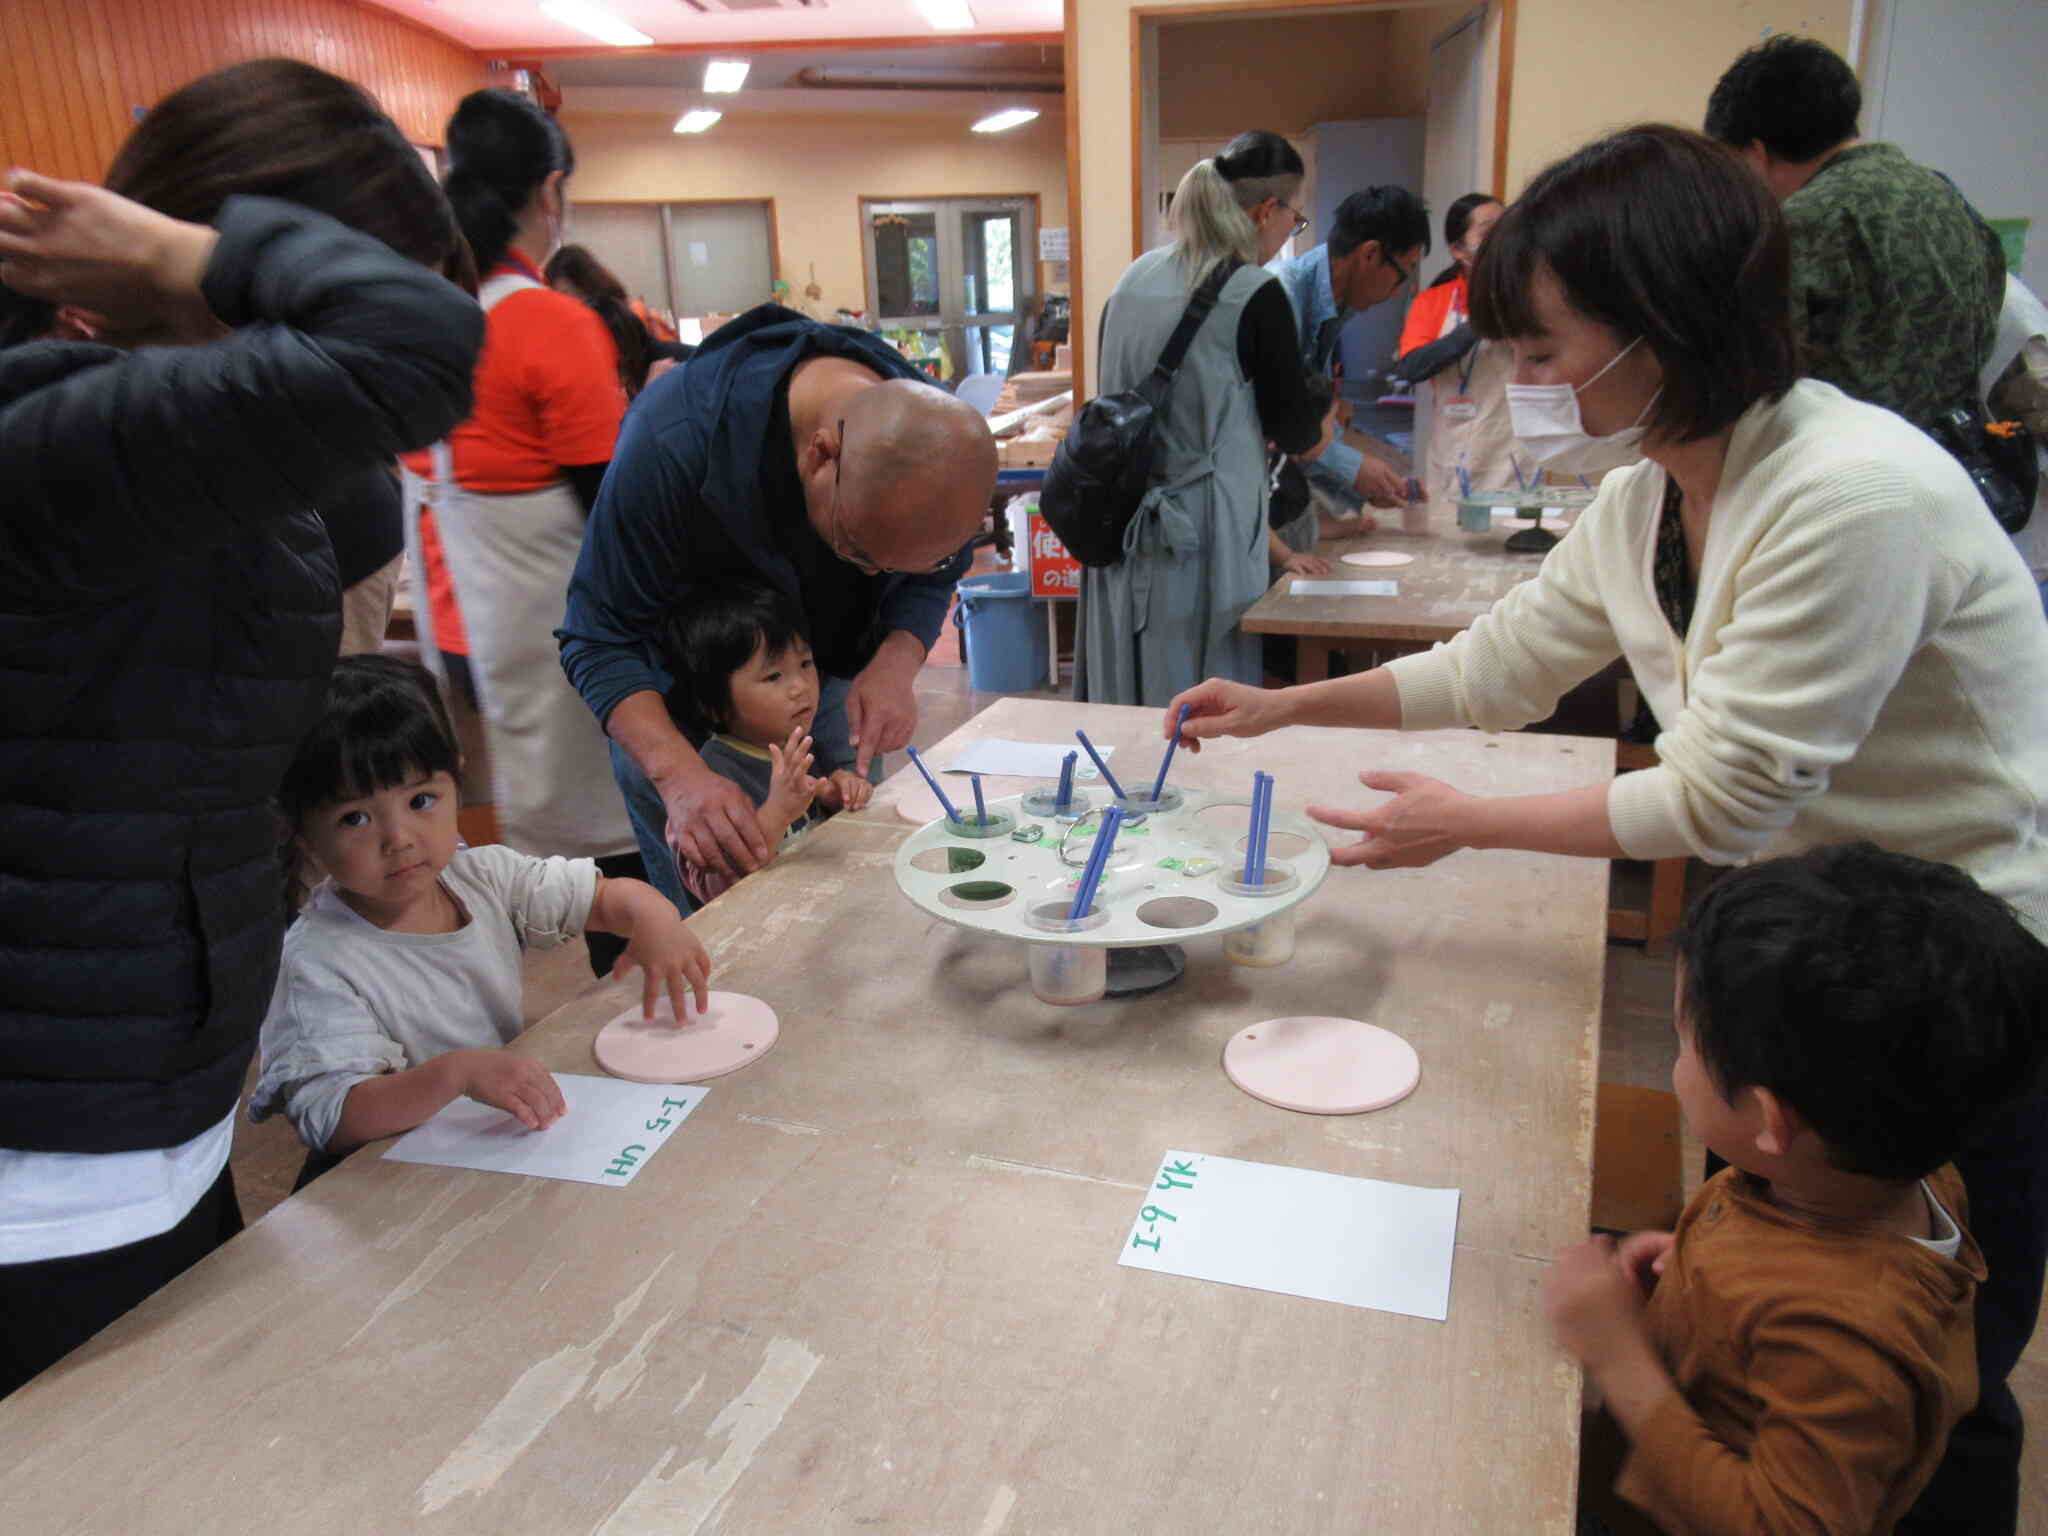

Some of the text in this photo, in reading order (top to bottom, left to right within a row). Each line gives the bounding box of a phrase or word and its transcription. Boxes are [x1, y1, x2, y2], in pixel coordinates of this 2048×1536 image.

[604, 1096, 687, 1177] I-5 UH
[1132, 1205, 1177, 1253] I-9
